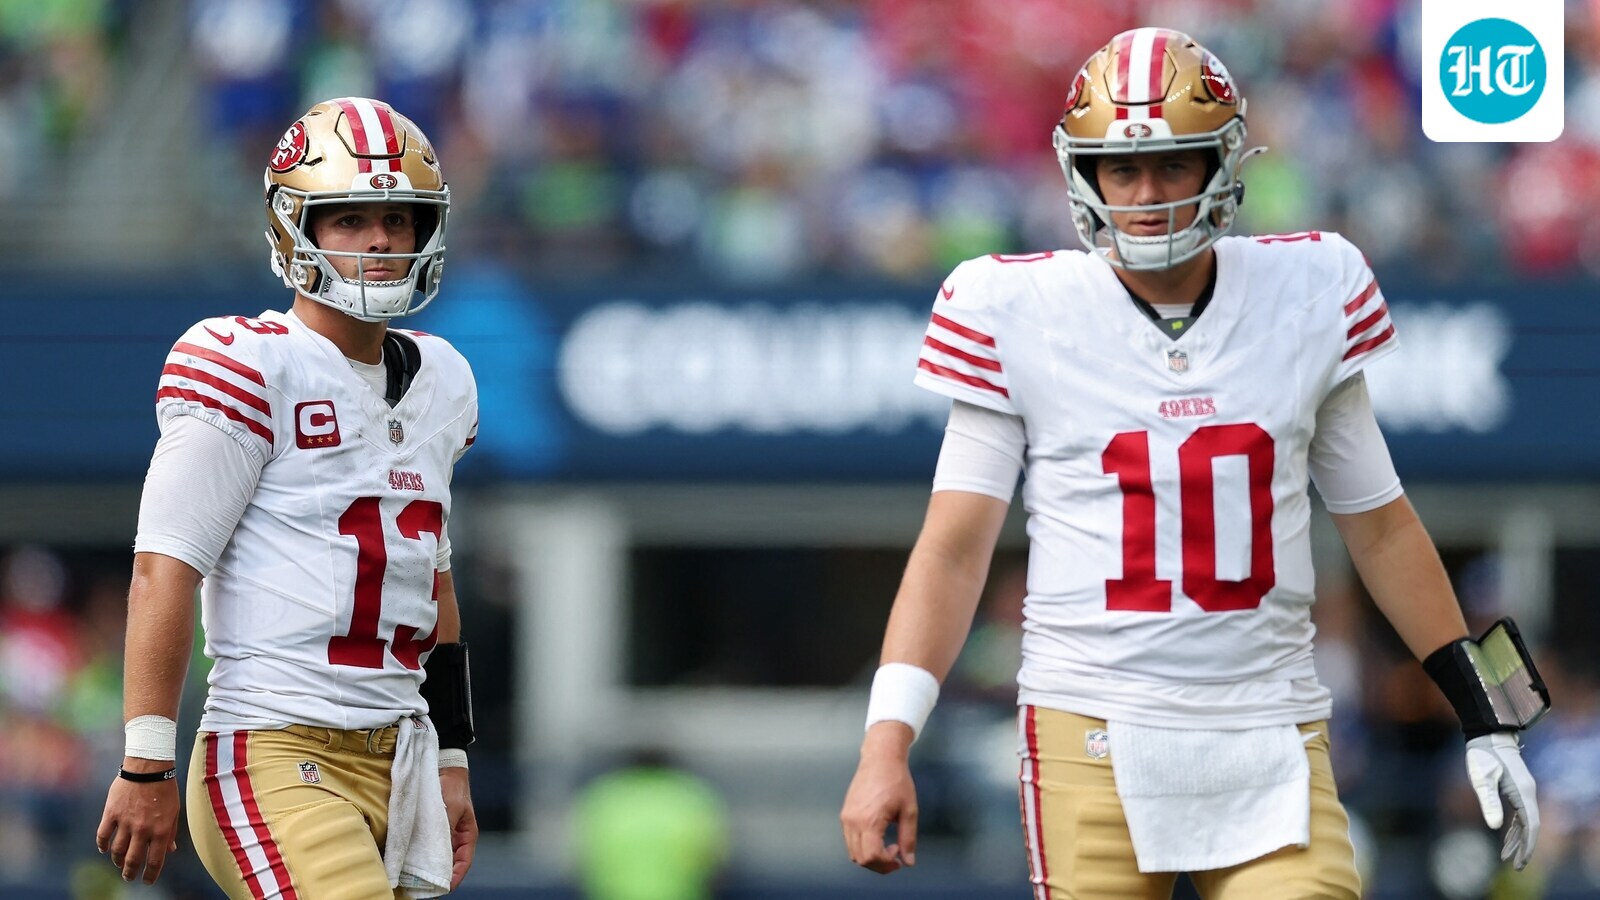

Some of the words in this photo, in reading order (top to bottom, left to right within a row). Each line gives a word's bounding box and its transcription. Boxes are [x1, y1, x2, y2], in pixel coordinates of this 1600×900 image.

[299, 405, 336, 436] C
[1158, 397, 1216, 418] 49ERS
[388, 469, 425, 492] 49ERS
[1101, 422, 1276, 613] 10
[327, 496, 442, 671] 13
